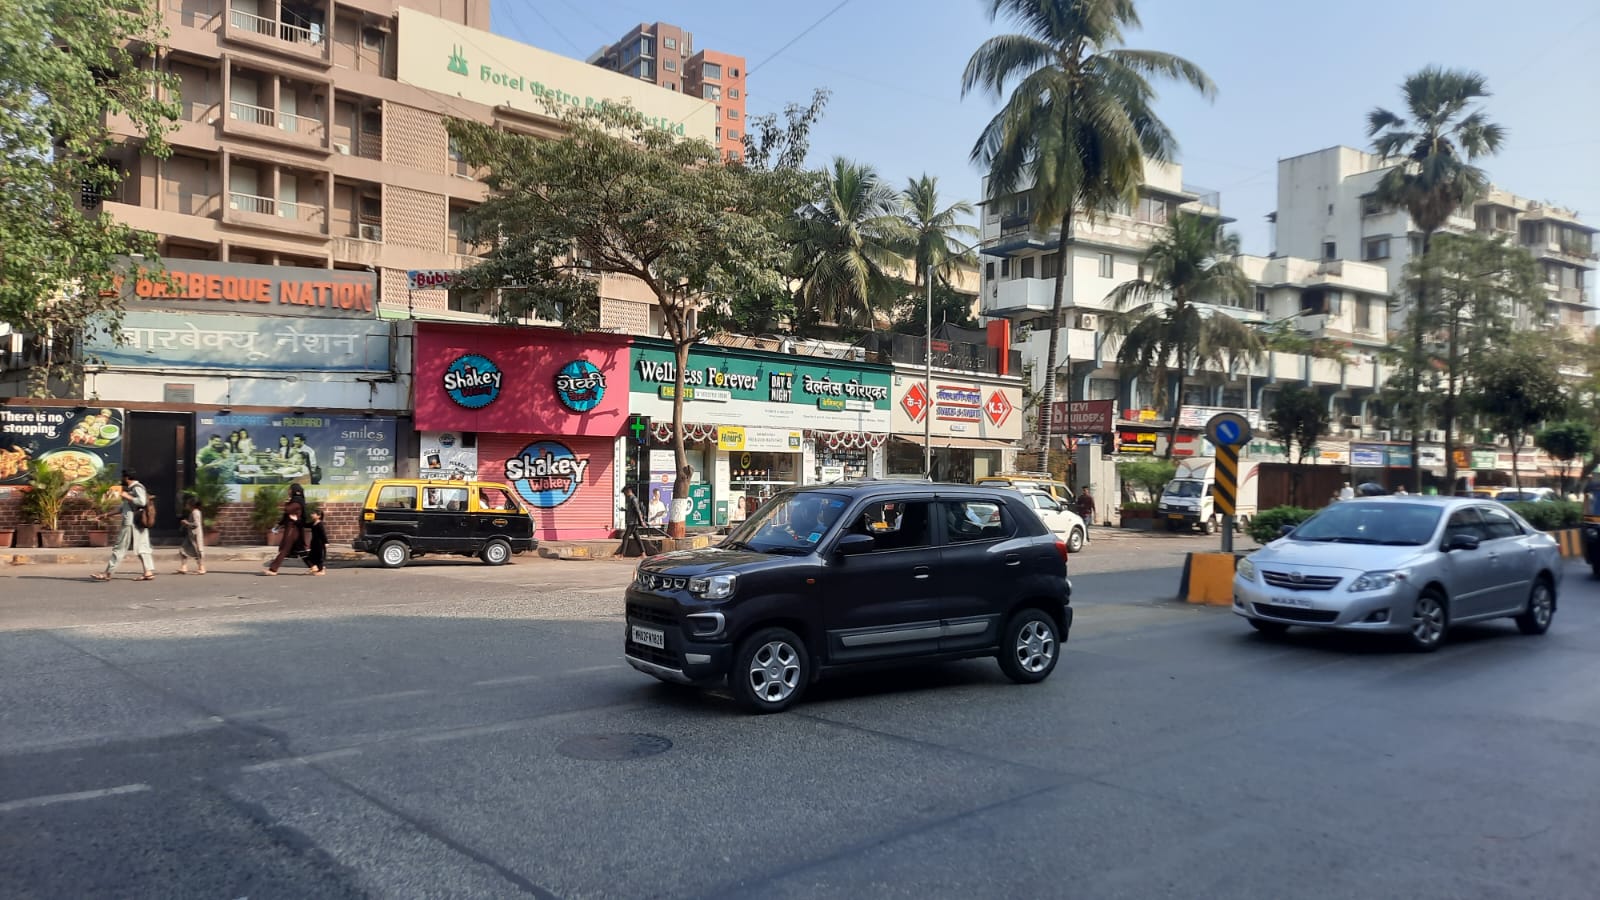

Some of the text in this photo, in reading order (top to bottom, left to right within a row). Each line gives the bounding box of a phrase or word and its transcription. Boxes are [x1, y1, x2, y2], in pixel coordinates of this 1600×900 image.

[479, 65, 525, 92] Hotel
[529, 81, 581, 107] Metro
[280, 280, 373, 313] NATION
[273, 324, 360, 355] नेशन
[444, 369, 502, 391] Shakey
[556, 372, 606, 391] शेकी
[708, 366, 759, 390] Forever
[771, 375, 792, 388] DAY &
[805, 374, 843, 395] वेलनेस
[771, 388, 792, 402] NIGHT
[0, 410, 63, 423] There is no
[3, 423, 56, 437] stopping
[340, 424, 385, 441] smiles
[366, 447, 389, 456] 100
[366, 465, 389, 474] 100
[506, 453, 588, 483] Shakey
[529, 477, 571, 493] Wakey
